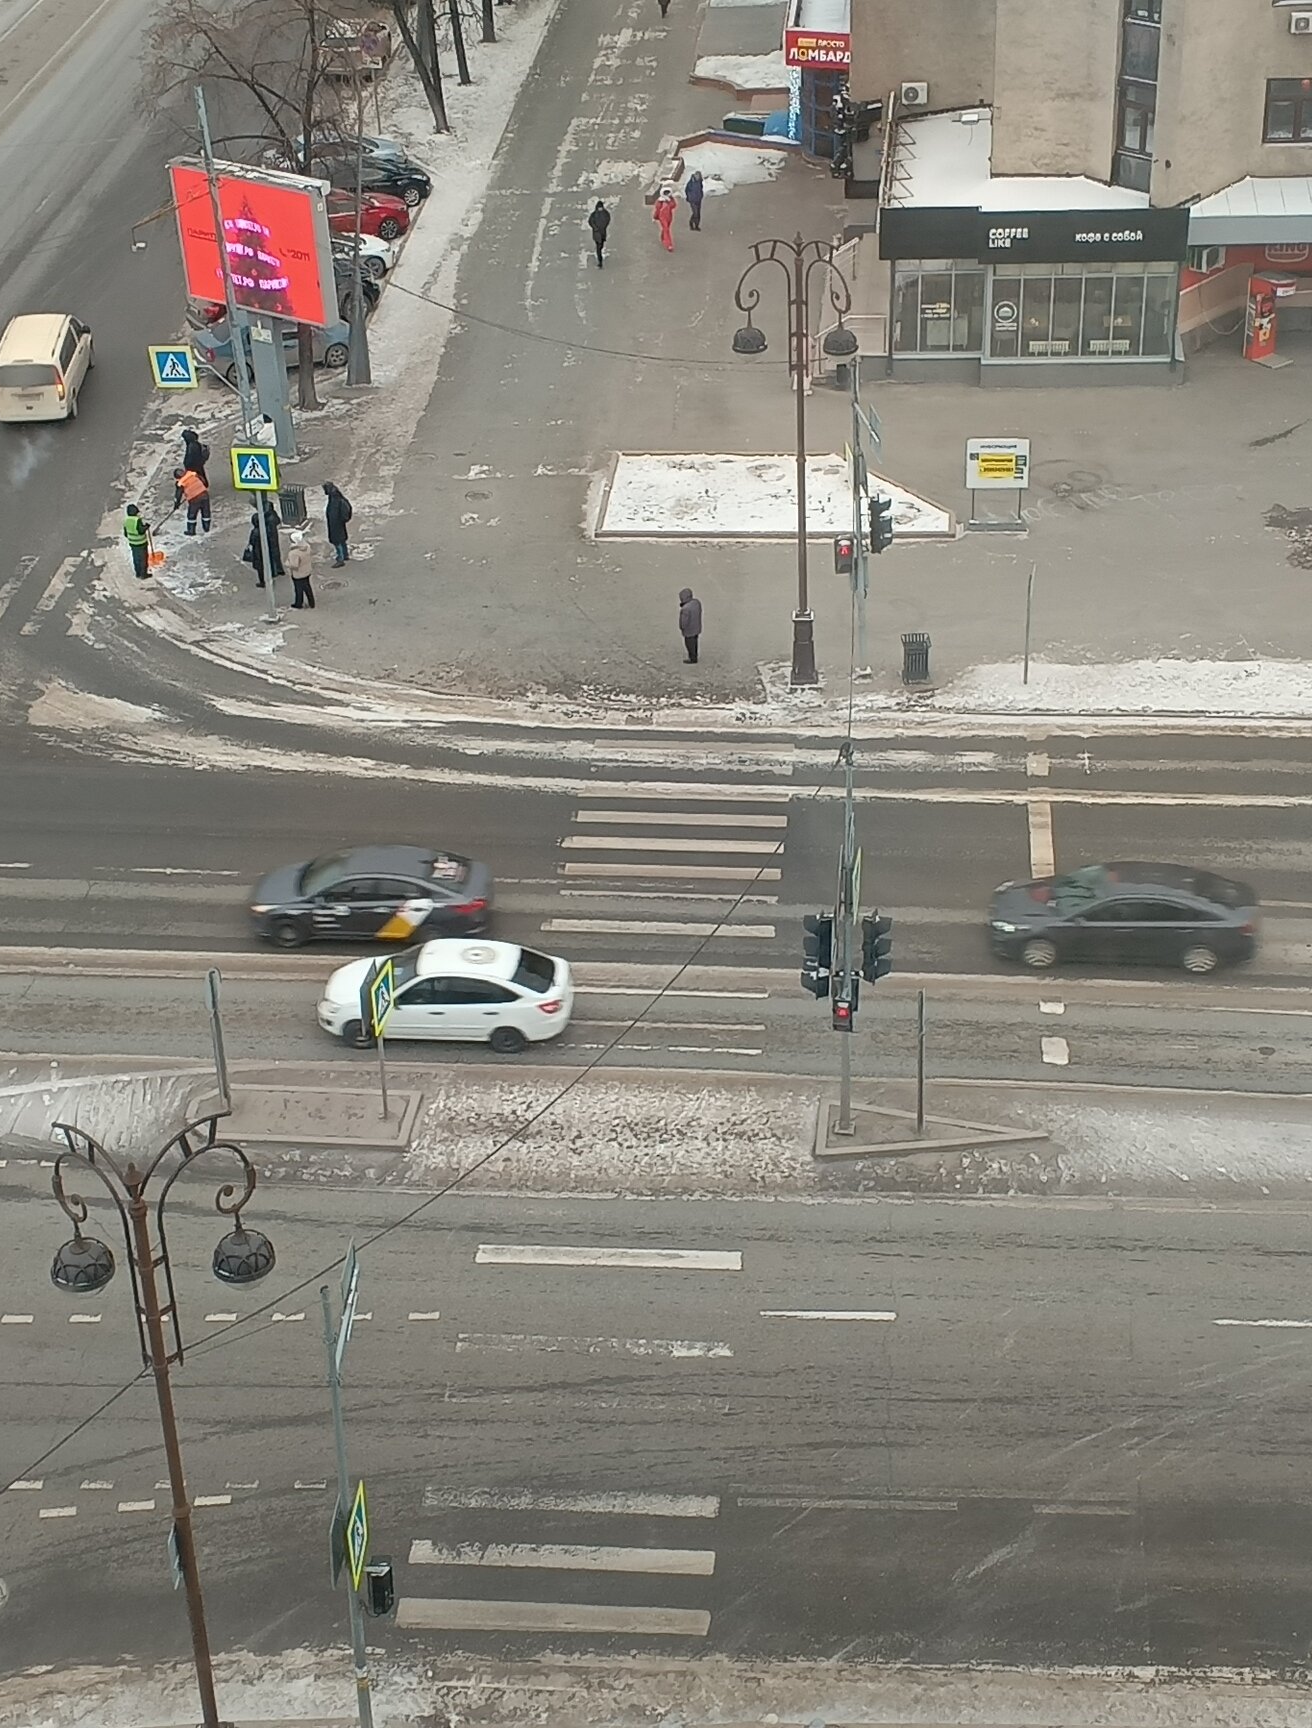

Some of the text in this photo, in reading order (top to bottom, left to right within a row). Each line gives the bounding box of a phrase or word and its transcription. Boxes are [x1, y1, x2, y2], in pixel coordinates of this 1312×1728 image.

[817, 39, 845, 48] ПРОСТО
[789, 47, 851, 63] ЛОМБАРД
[989, 227, 1028, 239] COFFEE
[989, 238, 1011, 248] LIKE
